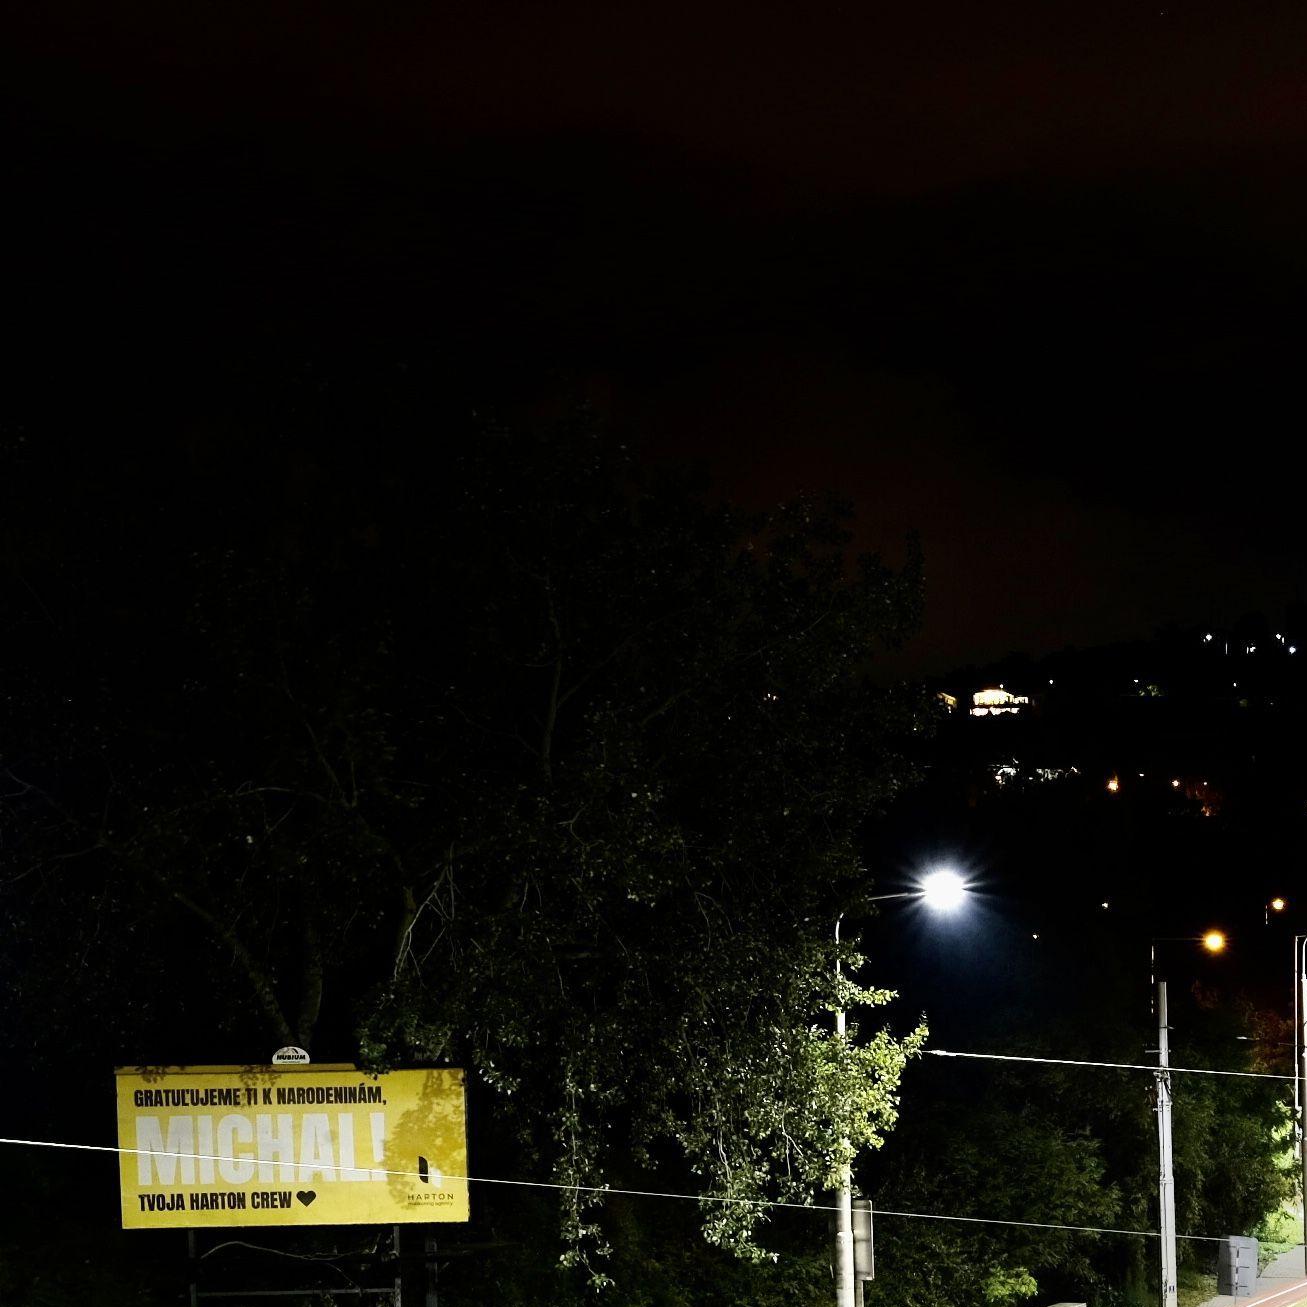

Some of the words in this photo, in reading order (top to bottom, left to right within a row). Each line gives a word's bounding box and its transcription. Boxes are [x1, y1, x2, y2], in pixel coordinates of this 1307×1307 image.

[134, 1088, 241, 1107] GRATUĽUJEME
[245, 1088, 258, 1106] TI
[262, 1087, 273, 1105] K
[276, 1082, 387, 1105] NARODENINÁM,
[135, 1112, 388, 1186] MICHAL!
[138, 1194, 186, 1212] TVOJA
[190, 1192, 246, 1210] HARTON
[250, 1191, 292, 1209] CREW
[407, 1193, 454, 1201] HARTON
